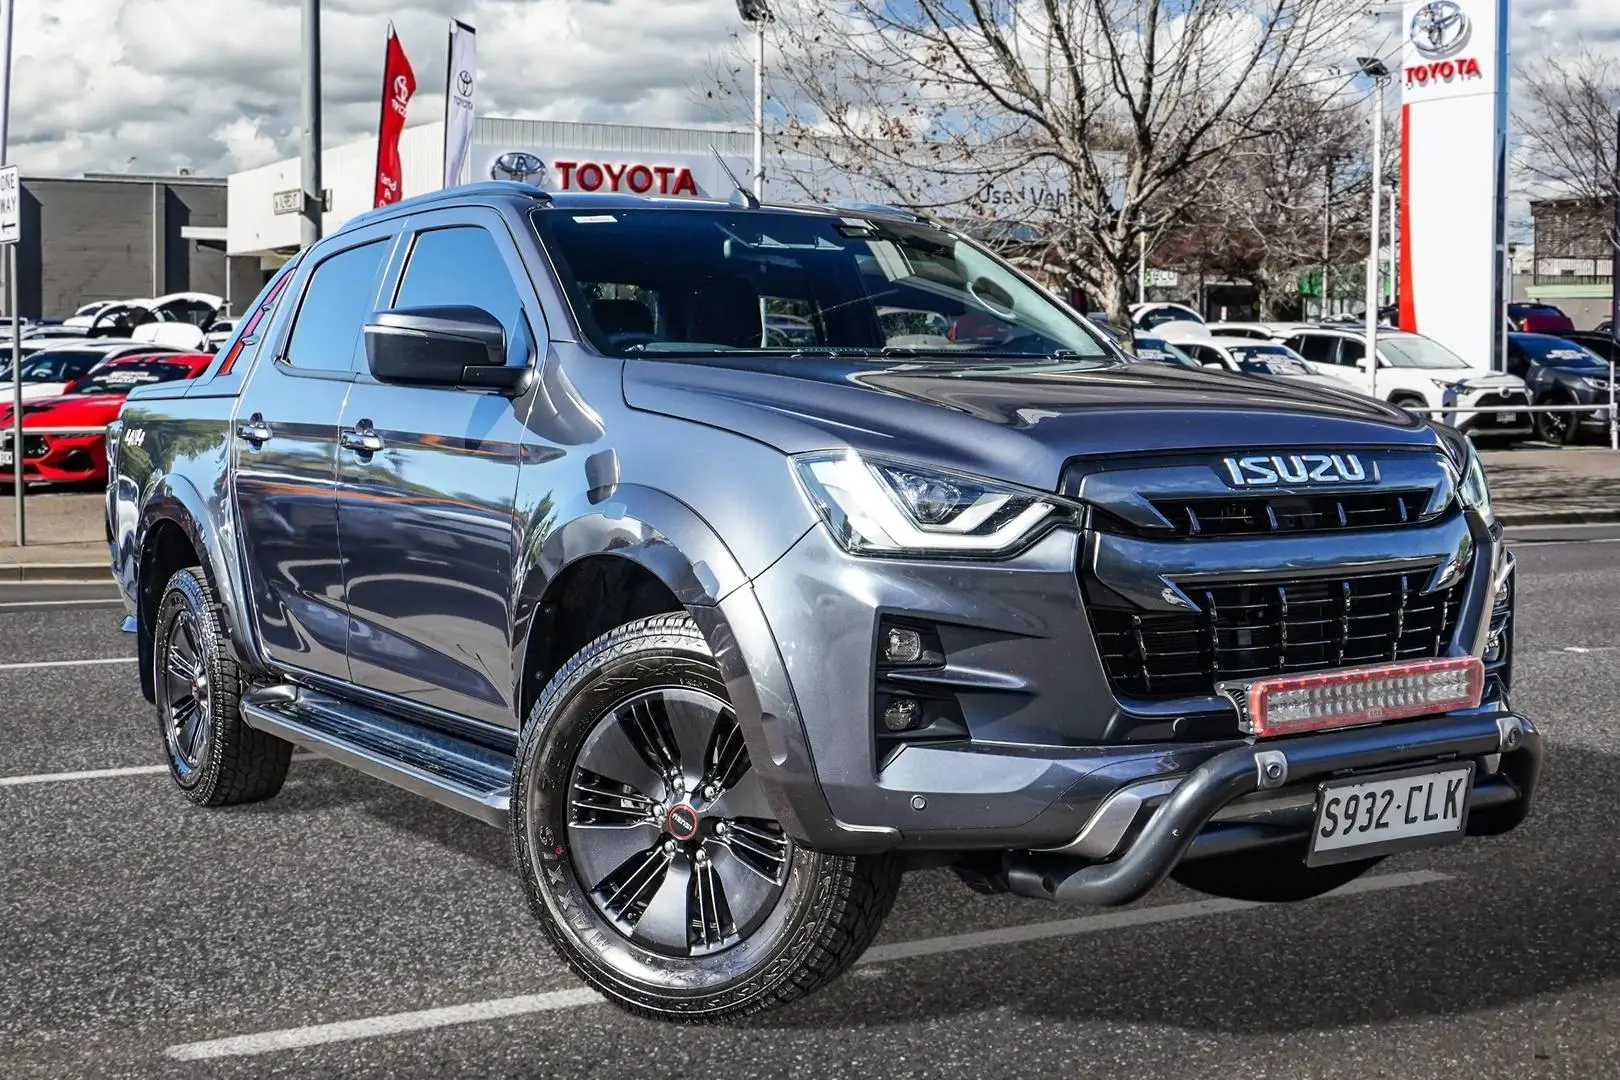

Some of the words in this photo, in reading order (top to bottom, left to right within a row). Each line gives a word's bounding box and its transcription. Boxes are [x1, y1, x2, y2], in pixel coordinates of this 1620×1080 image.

[1404, 58, 1481, 83] TOYOTA
[453, 95, 473, 110] TOYOTA
[0, 172, 15, 191] ONE
[554, 161, 698, 196] TOYOTA
[0, 196, 16, 213] WAY
[1223, 454, 1366, 486] ISUZU
[672, 812, 693, 831] ISUZU
